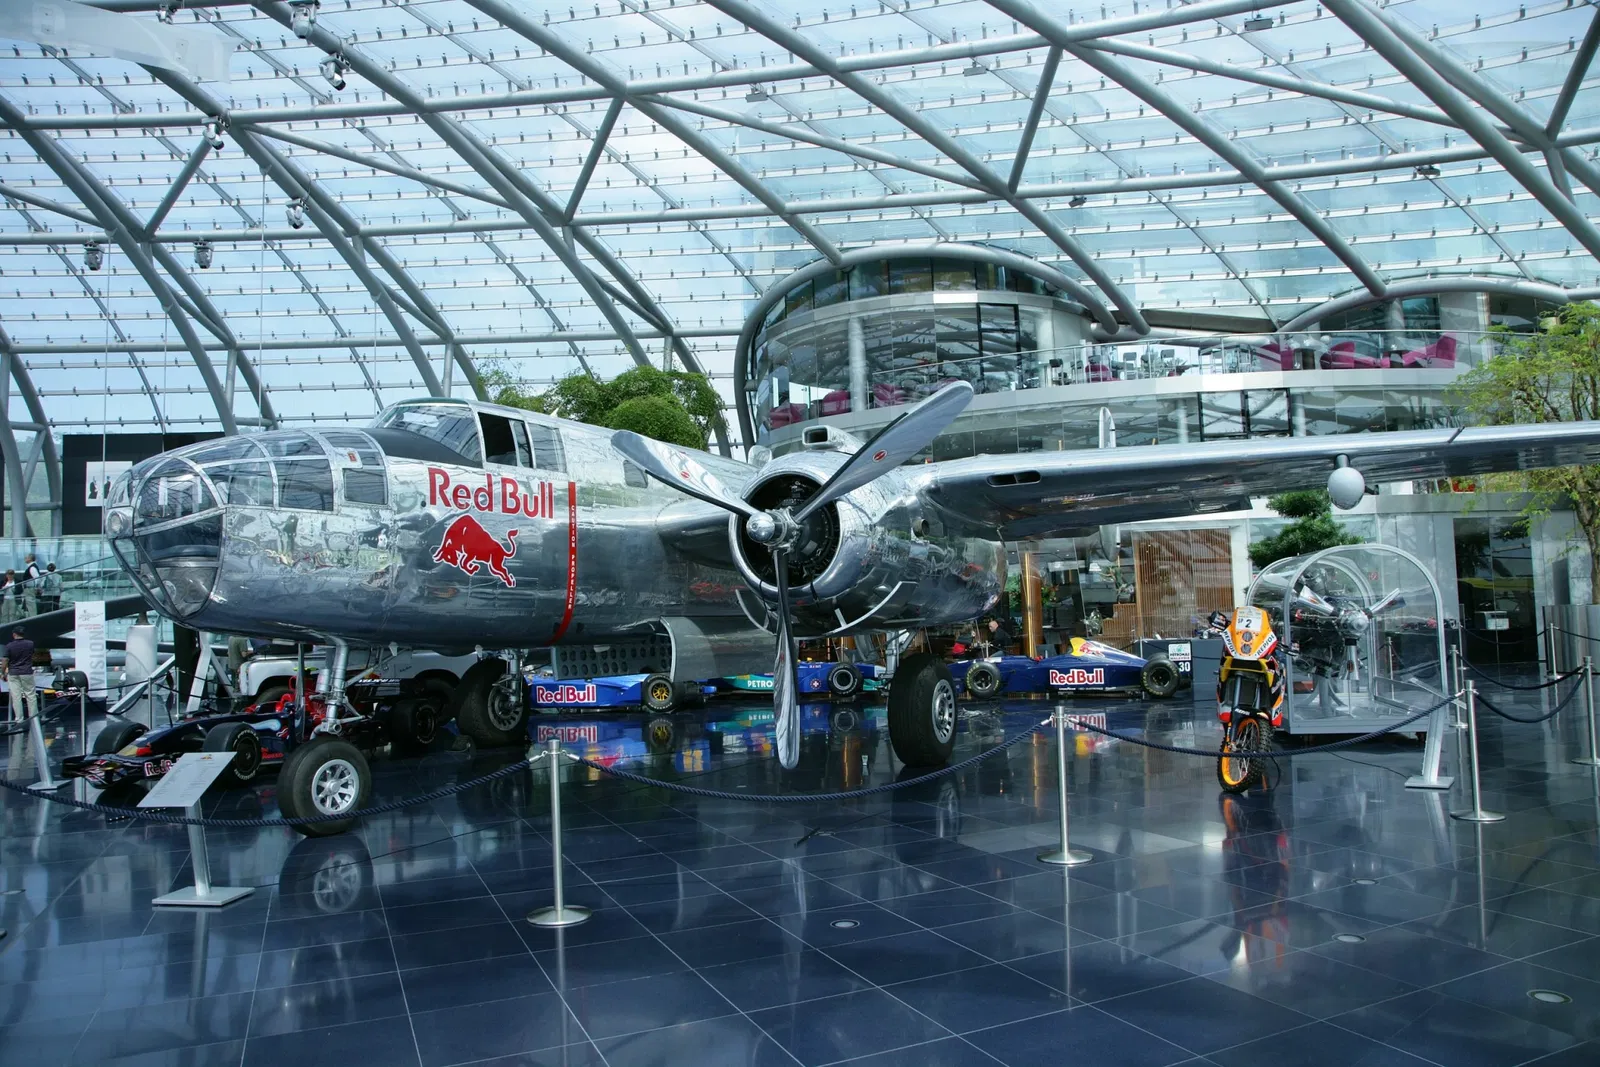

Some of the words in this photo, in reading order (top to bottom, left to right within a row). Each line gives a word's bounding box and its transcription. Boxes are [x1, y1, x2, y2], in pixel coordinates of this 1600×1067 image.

[427, 467, 494, 512] Red
[501, 477, 554, 519] Bull
[567, 554, 577, 610] PROPELLER
[1245, 618, 1252, 628] 2
[89, 630, 105, 690] VISION
[1178, 661, 1191, 672] 30
[747, 680, 773, 688] PETRO
[1050, 669, 1076, 685] Red
[1076, 668, 1105, 685] Bull
[536, 685, 563, 703] Red
[565, 684, 596, 703] Bull
[144, 759, 167, 777] Red
